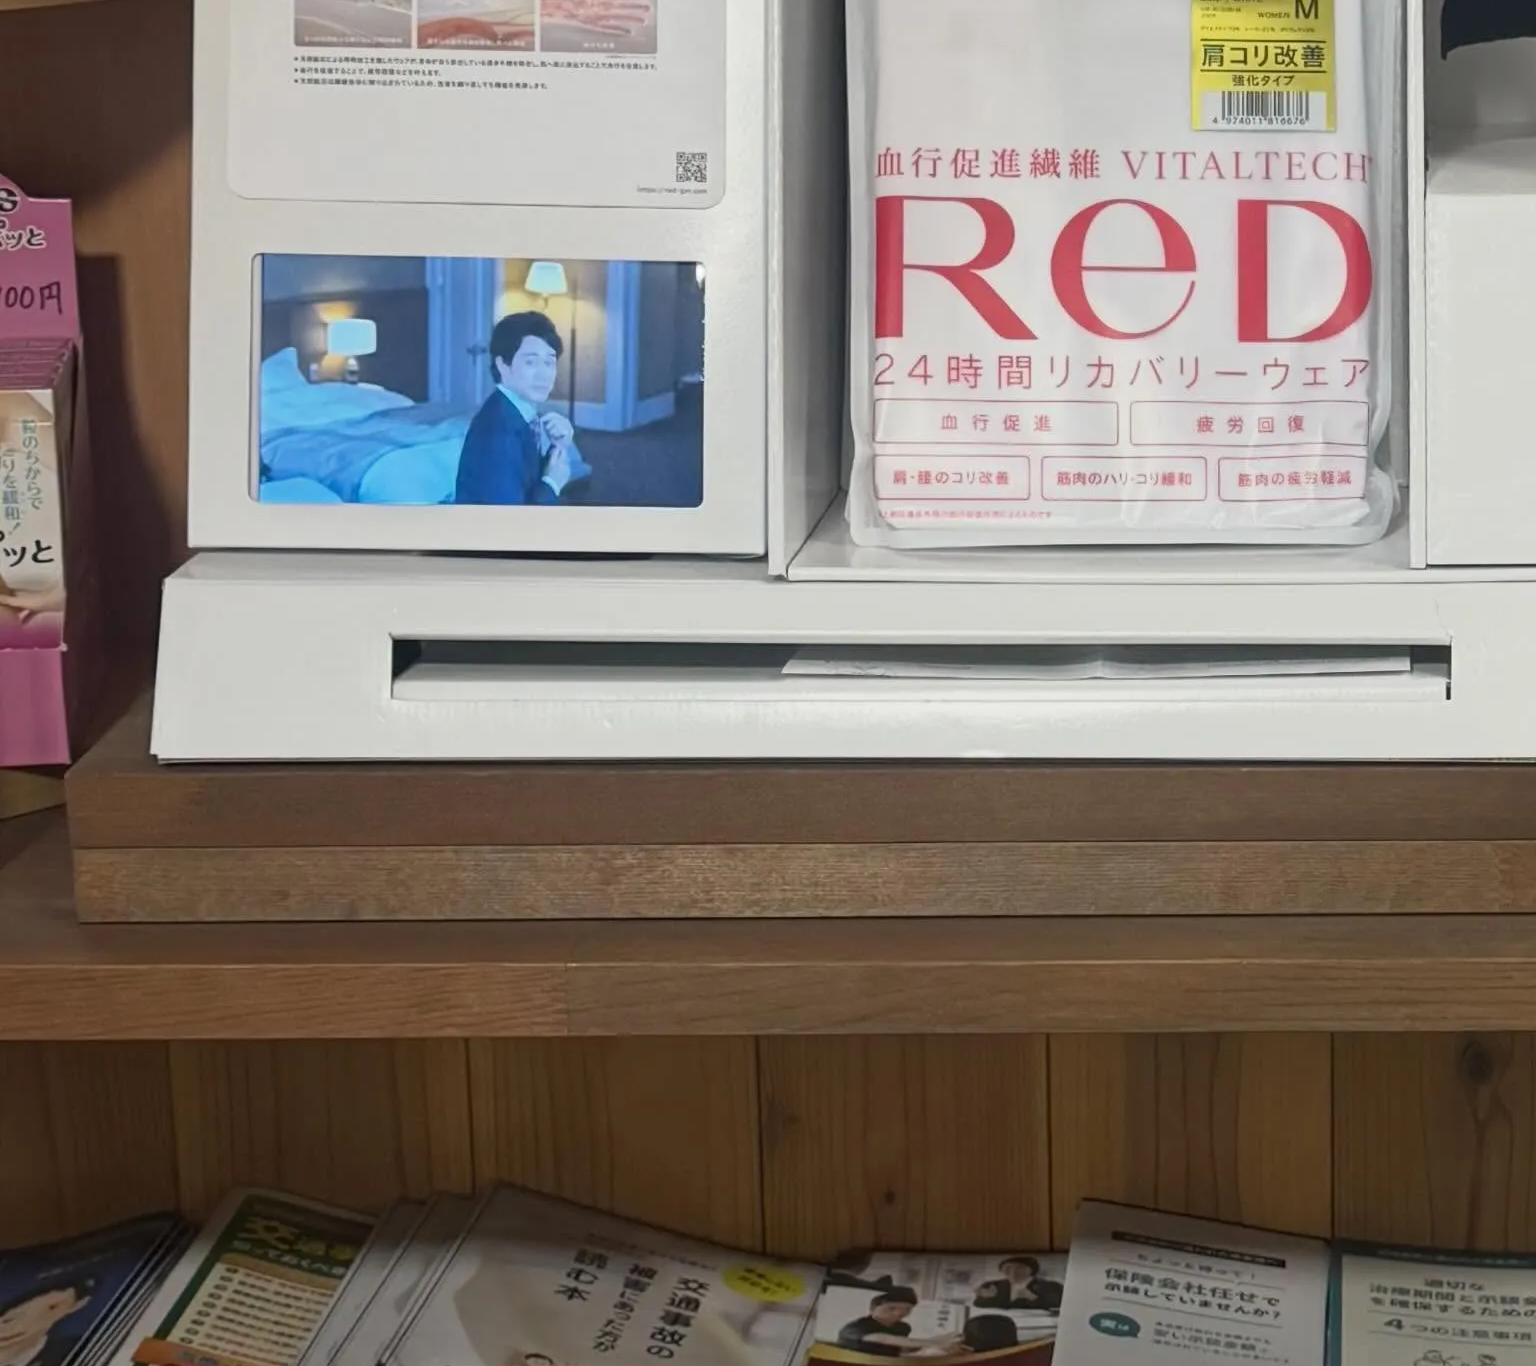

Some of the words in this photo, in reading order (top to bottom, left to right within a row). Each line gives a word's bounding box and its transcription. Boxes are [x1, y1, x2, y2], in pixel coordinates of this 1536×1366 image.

[1201, 43, 1326, 69] 肩コリ改善
[1231, 74, 1296, 88] 強化タイプ
[875, 146, 1101, 180] 血行促進繊維
[873, 352, 1371, 391] 24時間リカバリーウェア
[940, 413, 1054, 434] 血行促進
[1196, 414, 1306, 435] 疲労回復
[1236, 472, 1353, 488] 筋肉の疲労軽減
